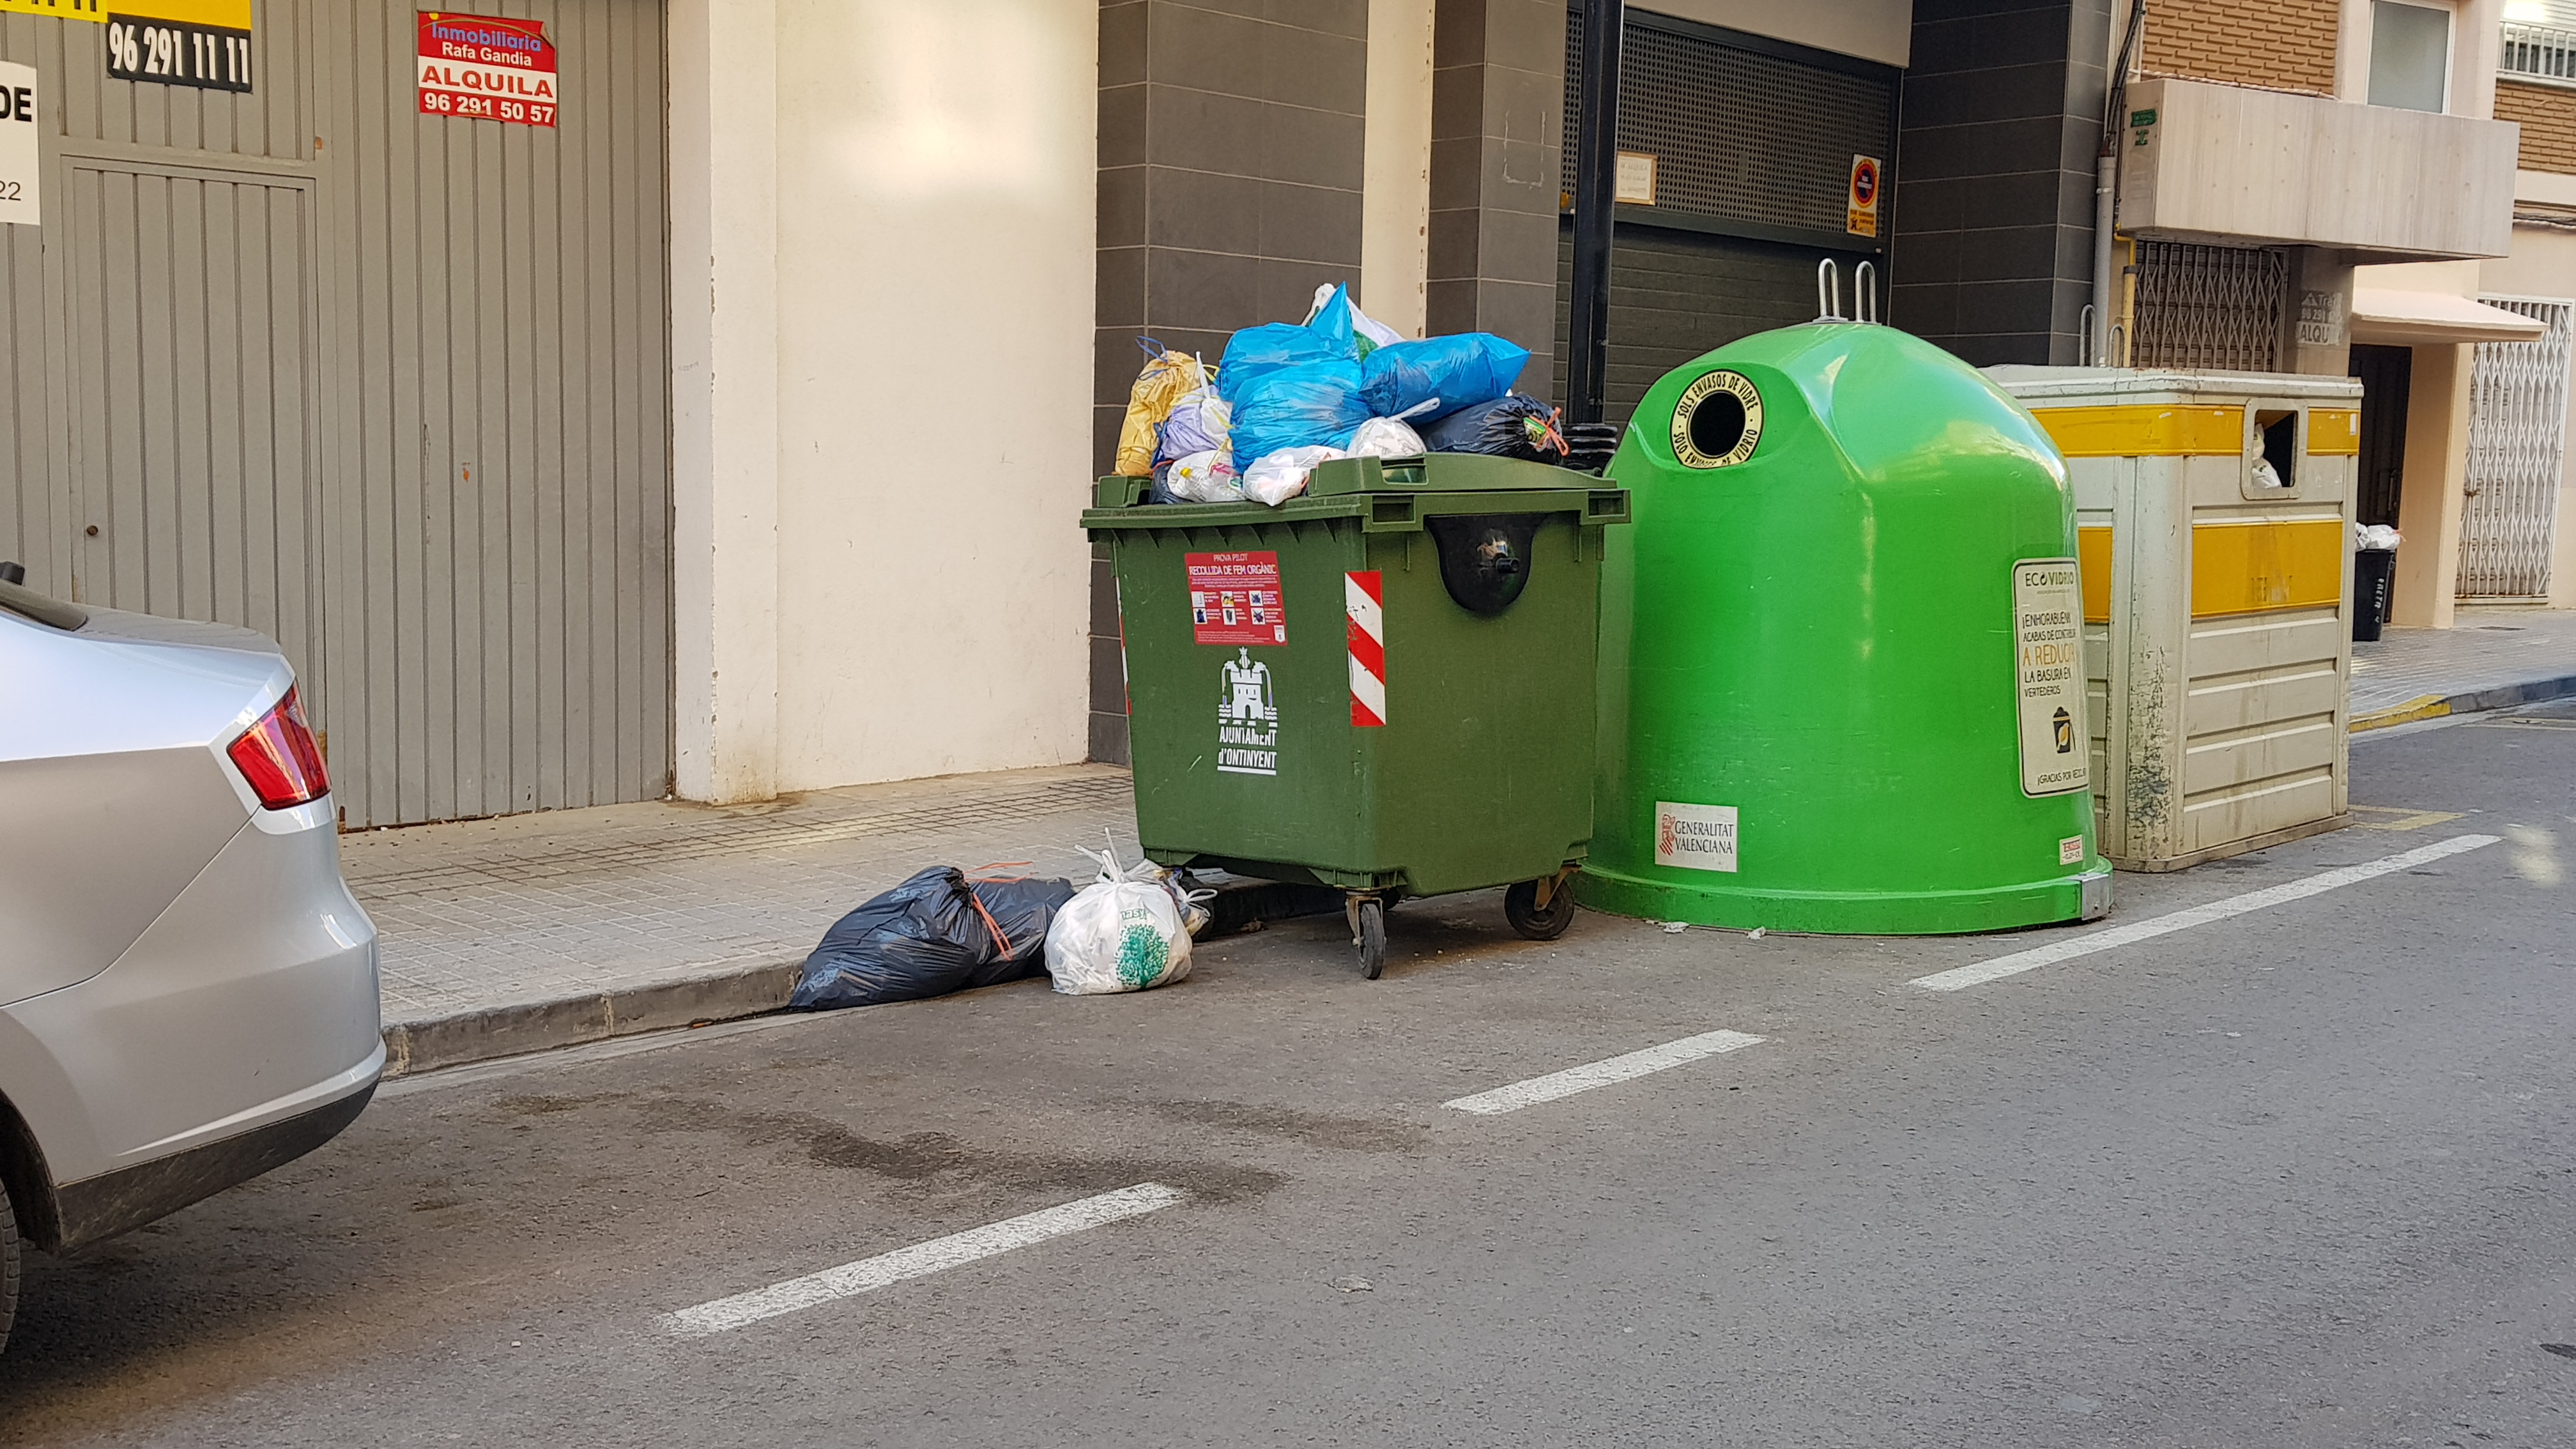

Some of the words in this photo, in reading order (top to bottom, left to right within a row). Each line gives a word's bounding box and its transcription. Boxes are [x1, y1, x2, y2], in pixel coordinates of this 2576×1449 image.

[432, 22, 540, 51] Inmobiliaria
[109, 22, 139, 72] 96
[144, 26, 183, 77] 291
[193, 33, 216, 80] 11
[226, 36, 249, 84] 11
[442, 42, 475, 59] Rafa
[480, 47, 532, 66] Gandia
[422, 66, 553, 98] ALQUILA
[425, 93, 450, 111] 96
[456, 96, 491, 115] 291
[500, 102, 524, 119] 50
[530, 105, 554, 123] 57
[1678, 395, 1695, 418] SOLS
[1692, 374, 1726, 398] ENVASOS
[1728, 376, 1740, 390] DE
[1738, 382, 1758, 411] VIDRE
[1674, 432, 1688, 454] SOLO
[1733, 429, 1758, 461] VIDRIO
[1223, 565, 1232, 574] DE
[2023, 631, 2046, 643] ACABAS
[2047, 629, 2055, 640] DE
[2023, 647, 2031, 666] A
[2025, 671, 2035, 683] LA
[2037, 668, 2063, 682] BASURA
[1675, 820, 1734, 837] GENERALITAT
[1675, 837, 1733, 854] VALENCIANA
